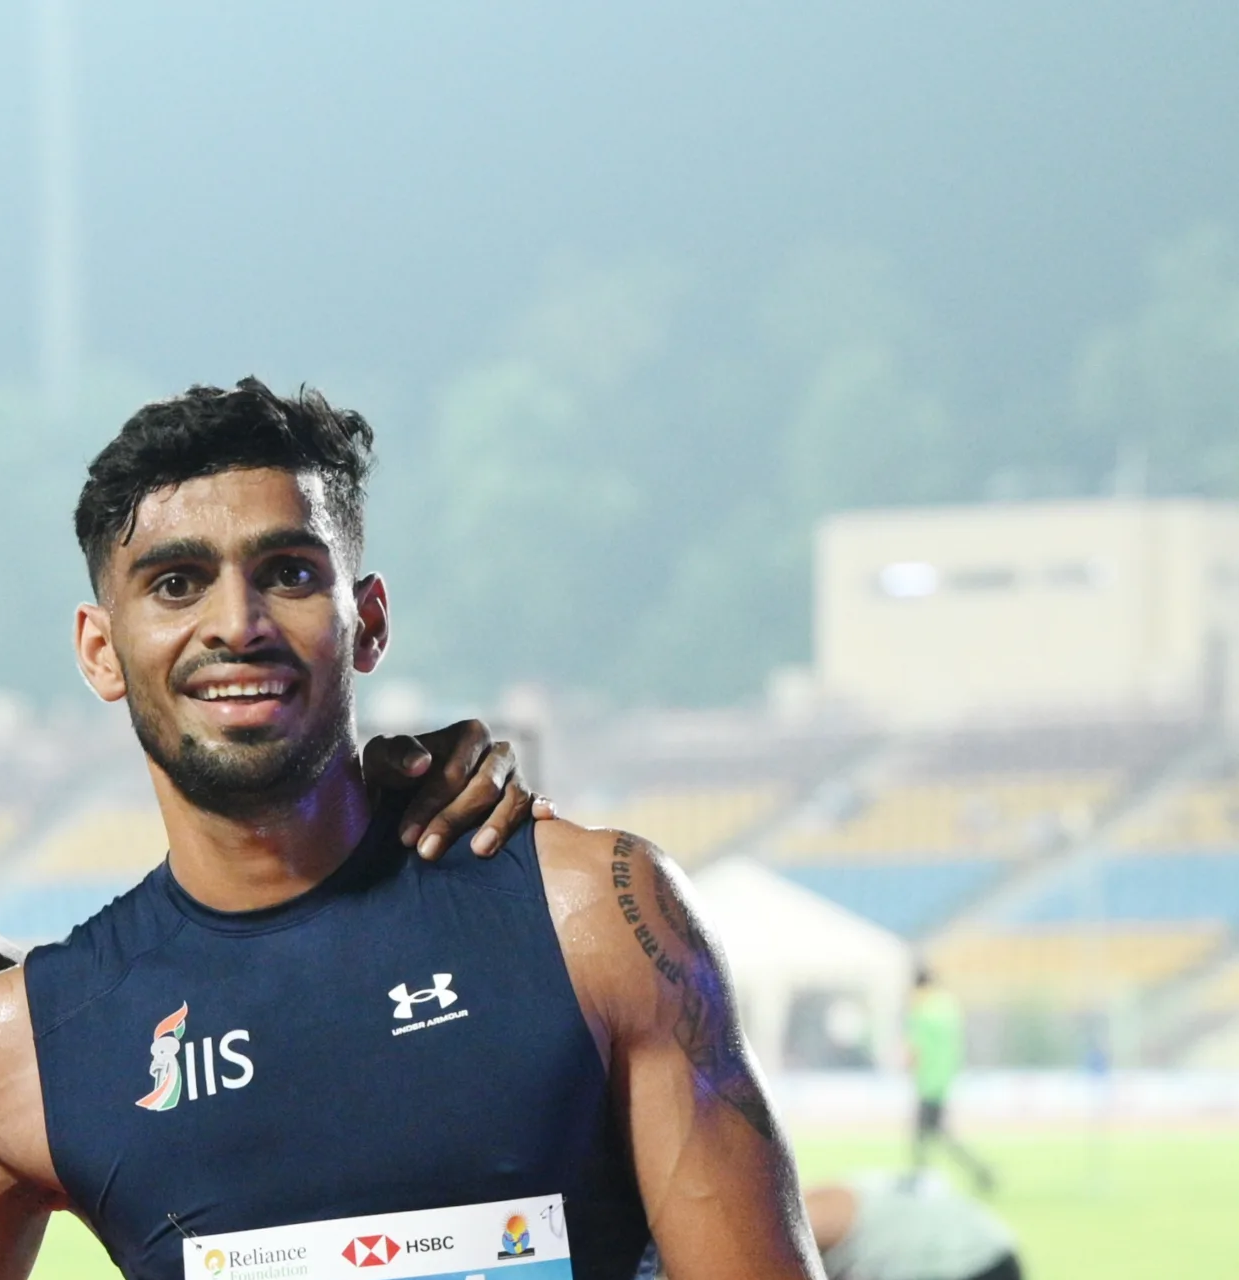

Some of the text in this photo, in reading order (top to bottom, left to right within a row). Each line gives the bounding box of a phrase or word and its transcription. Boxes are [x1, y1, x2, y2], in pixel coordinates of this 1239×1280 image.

[392, 1009, 468, 1036] UNDER ARMOUR
[185, 1029, 254, 1100] IIS
[406, 1235, 455, 1254] HSBC
[229, 1246, 307, 1269] Reliance
